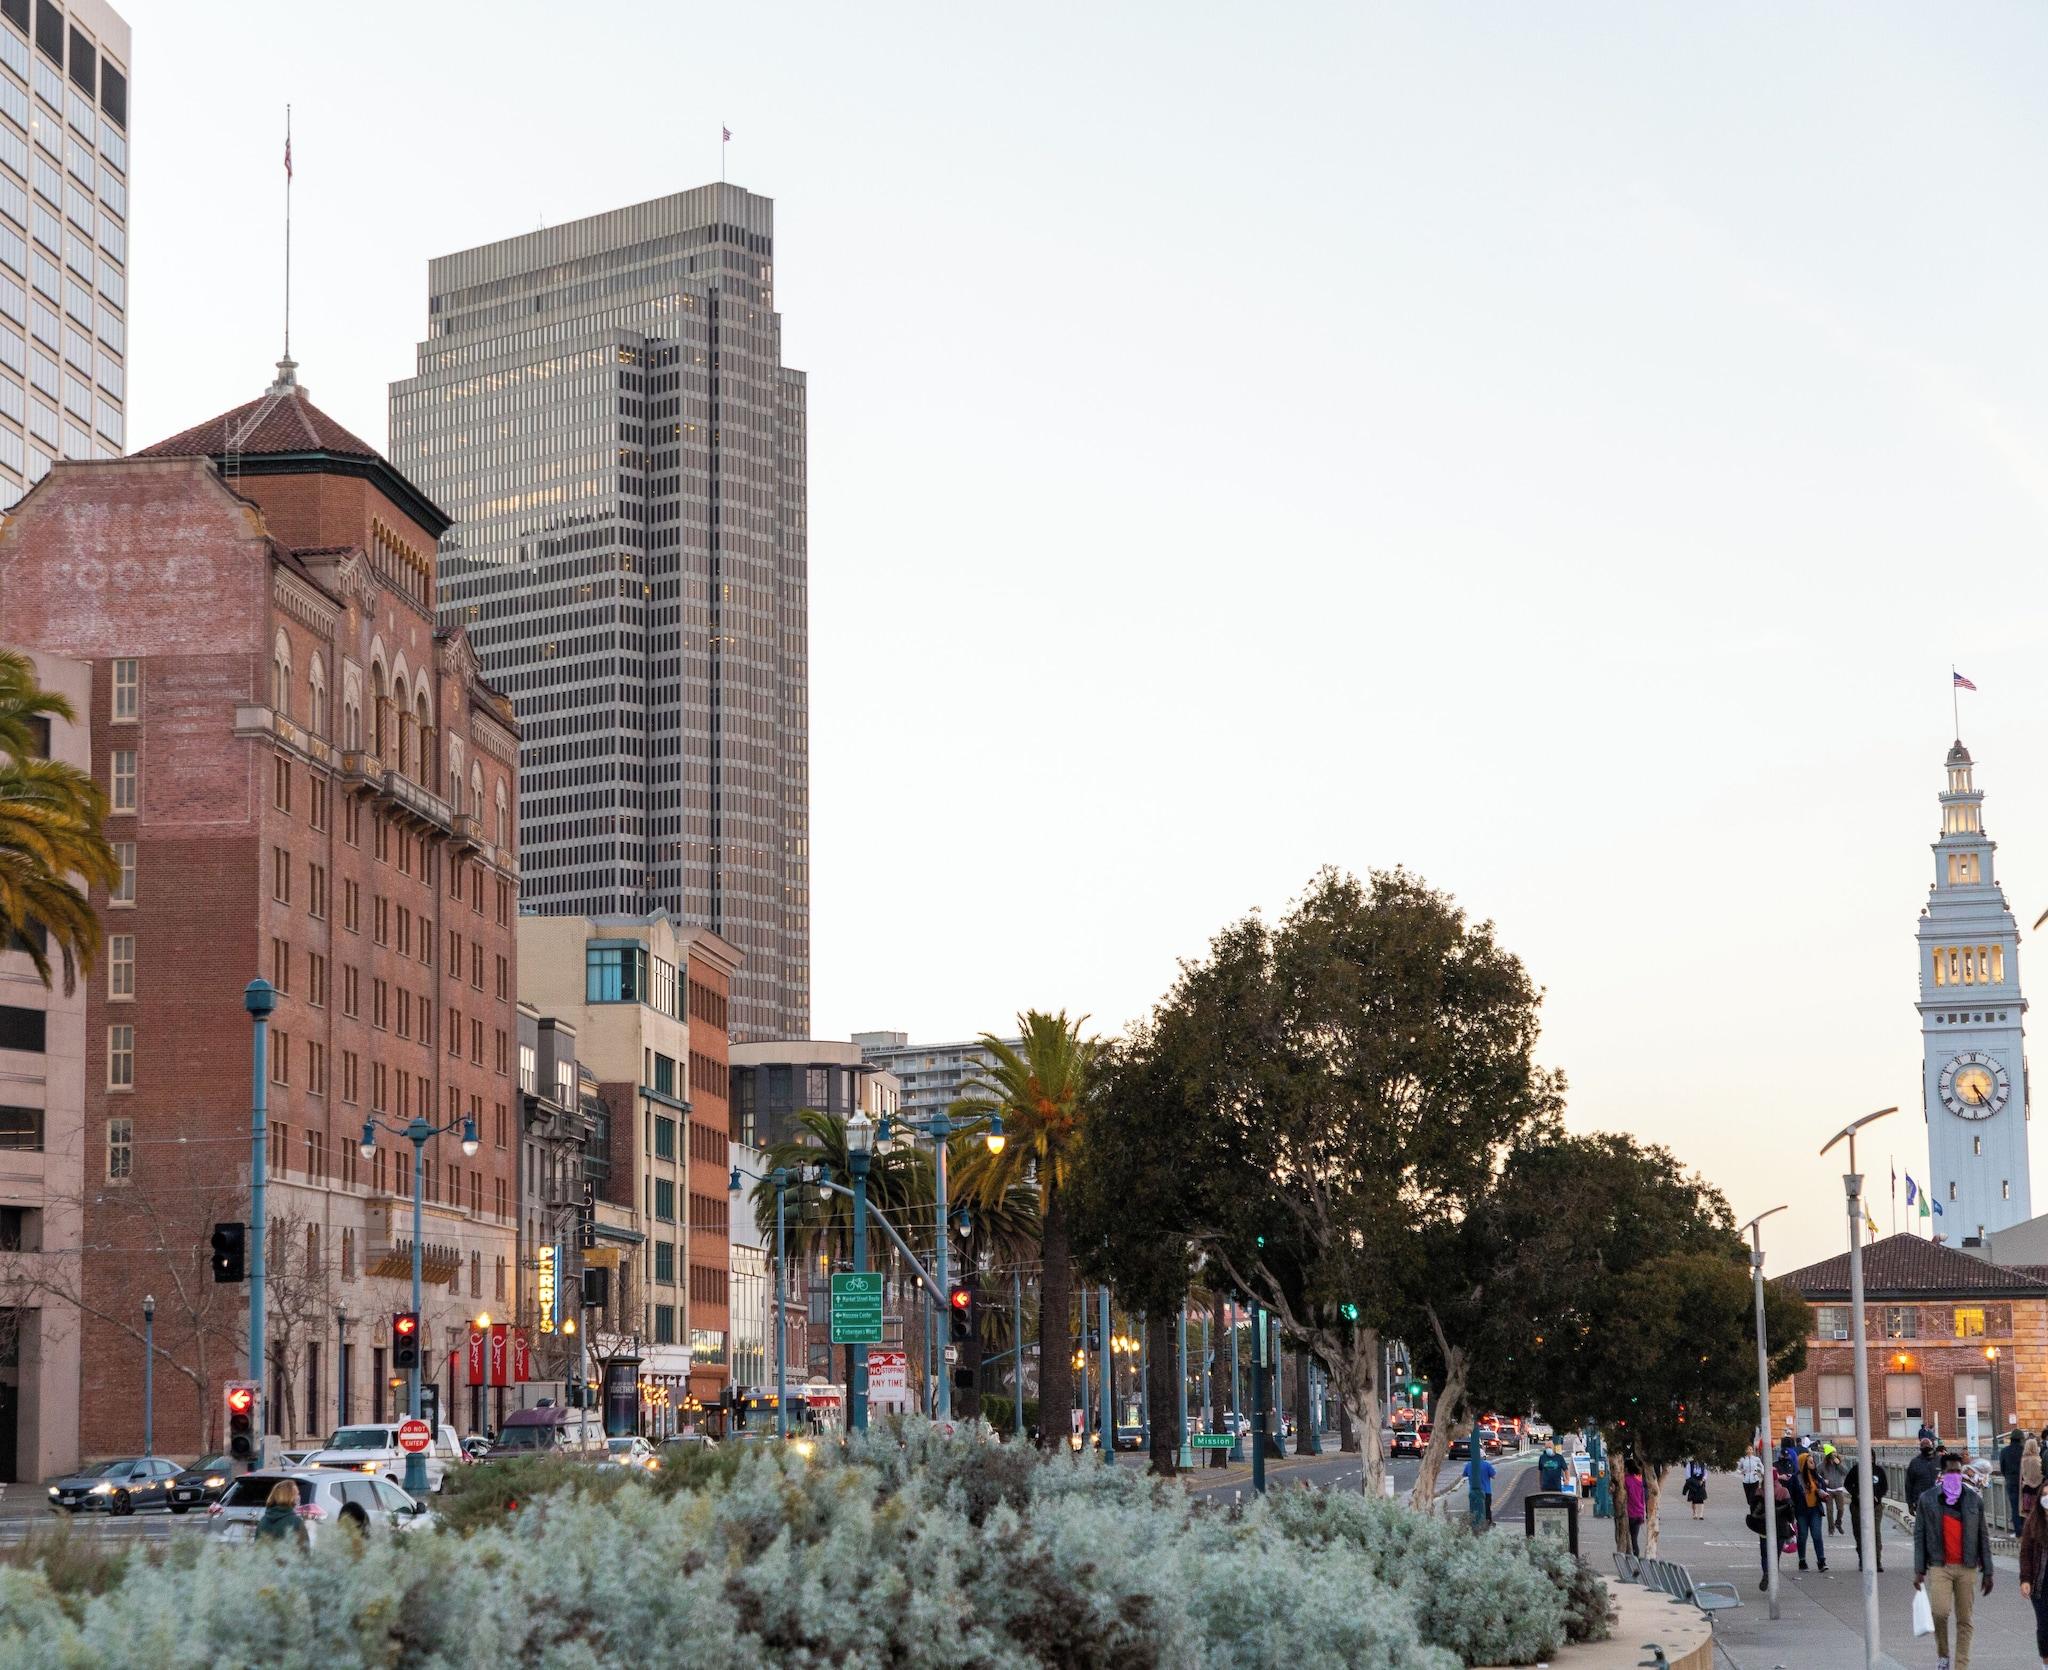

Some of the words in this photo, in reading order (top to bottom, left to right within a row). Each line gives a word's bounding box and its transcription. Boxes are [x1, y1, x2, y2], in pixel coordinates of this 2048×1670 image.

[583, 1183, 593, 1247] HOTEL
[872, 1380, 885, 1388] ANY
[888, 1380, 903, 1388] TIME
[1197, 1437, 1230, 1445] Mission
